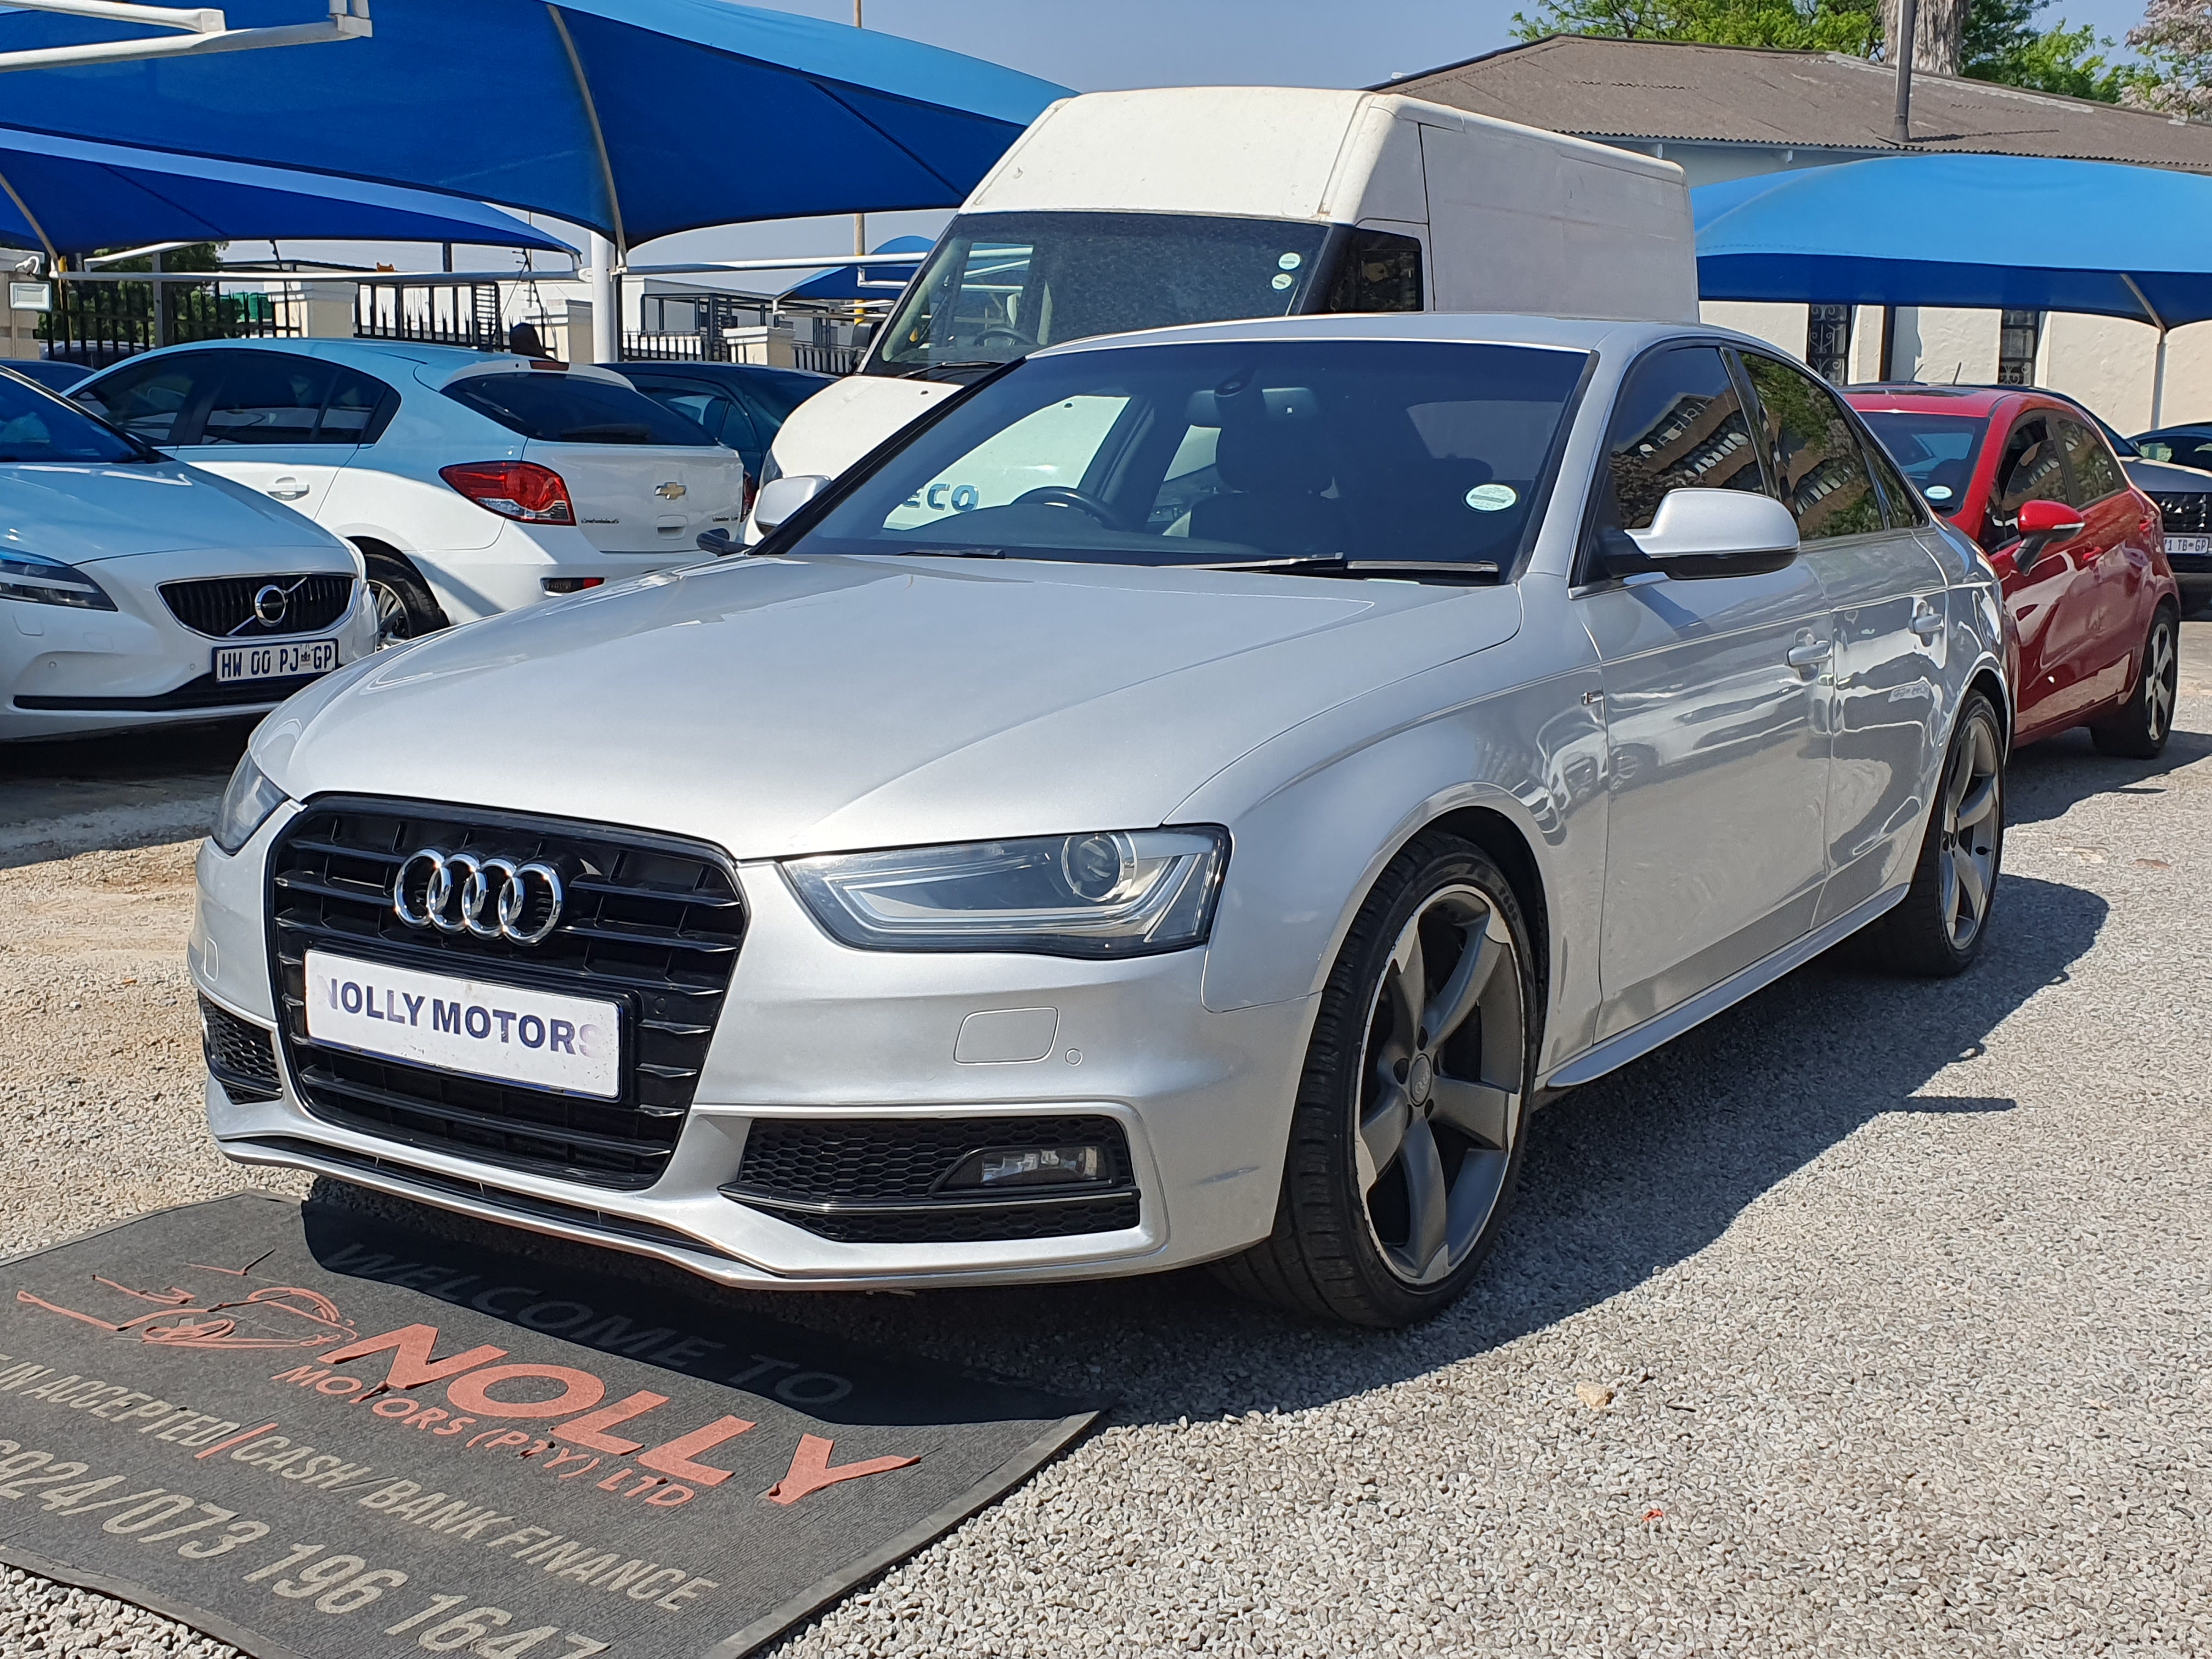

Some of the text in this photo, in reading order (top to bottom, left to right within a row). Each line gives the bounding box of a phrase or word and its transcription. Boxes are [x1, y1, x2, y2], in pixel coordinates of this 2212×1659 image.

[2177, 539, 2188, 551] TB
[2195, 539, 2207, 552] GP
[222, 652, 242, 679] HW
[280, 647, 299, 673] PJ
[313, 645, 332, 670] GP
[432, 998, 607, 1059] MOTORS
[321, 1242, 853, 1404] WELCOME TO
[268, 1365, 477, 1435] MOTORS
[597, 1468, 695, 1506] LTD
[317, 1323, 922, 1505] NOLLY
[242, 1542, 409, 1614] 196
[486, 1525, 720, 1612] FINANCE
